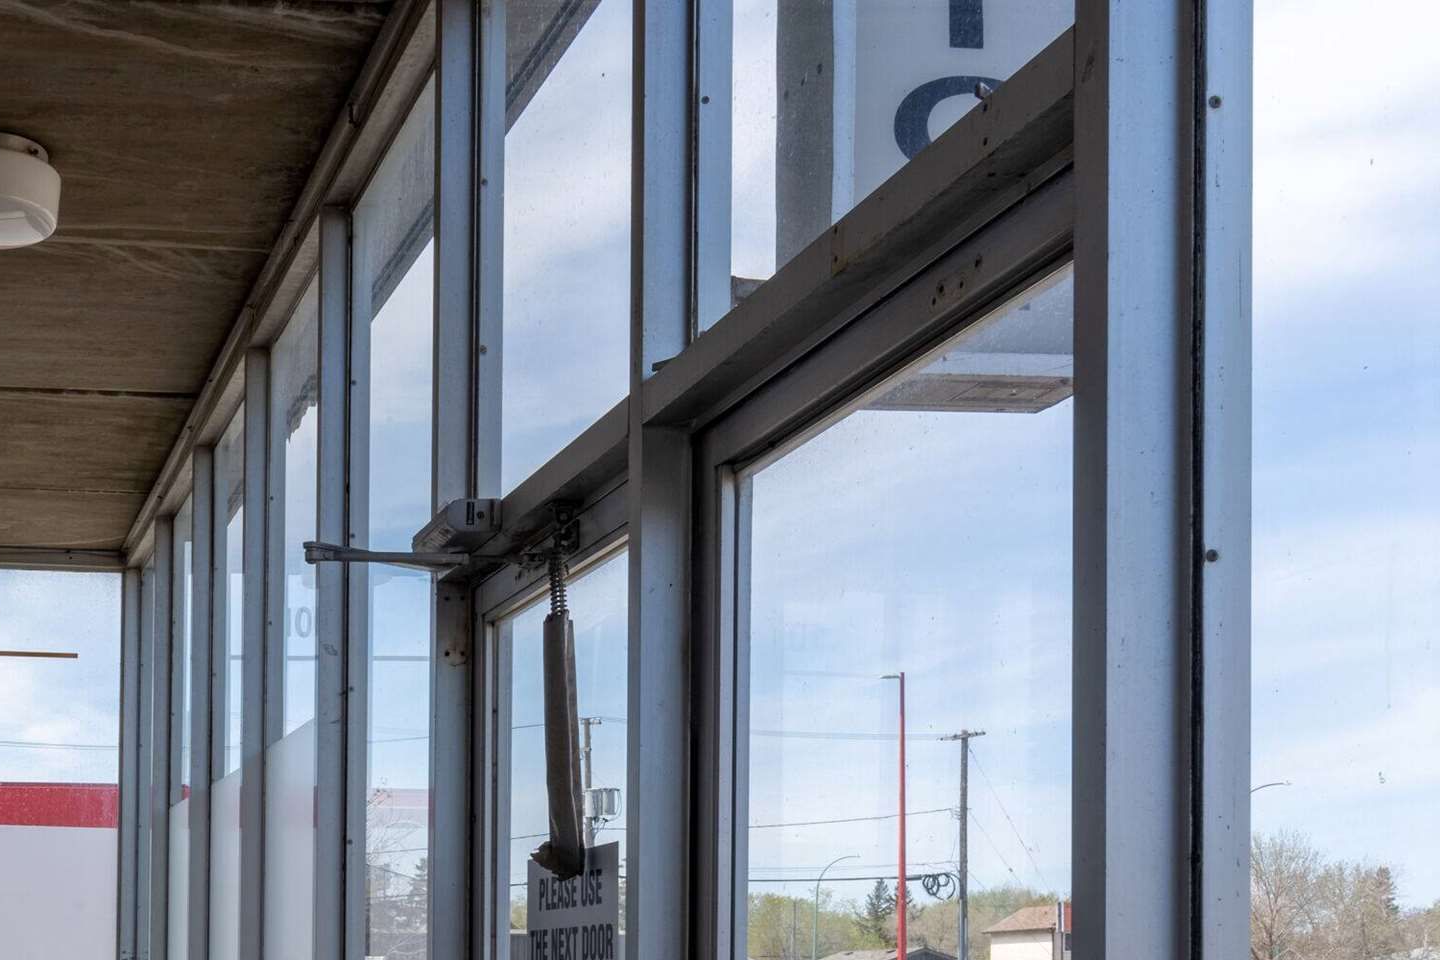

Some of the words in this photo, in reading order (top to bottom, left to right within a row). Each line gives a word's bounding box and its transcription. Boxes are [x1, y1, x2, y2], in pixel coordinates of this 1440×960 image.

[538, 875, 577, 913] PLEASE
[581, 867, 603, 908] USE
[582, 923, 614, 960] DOOR
